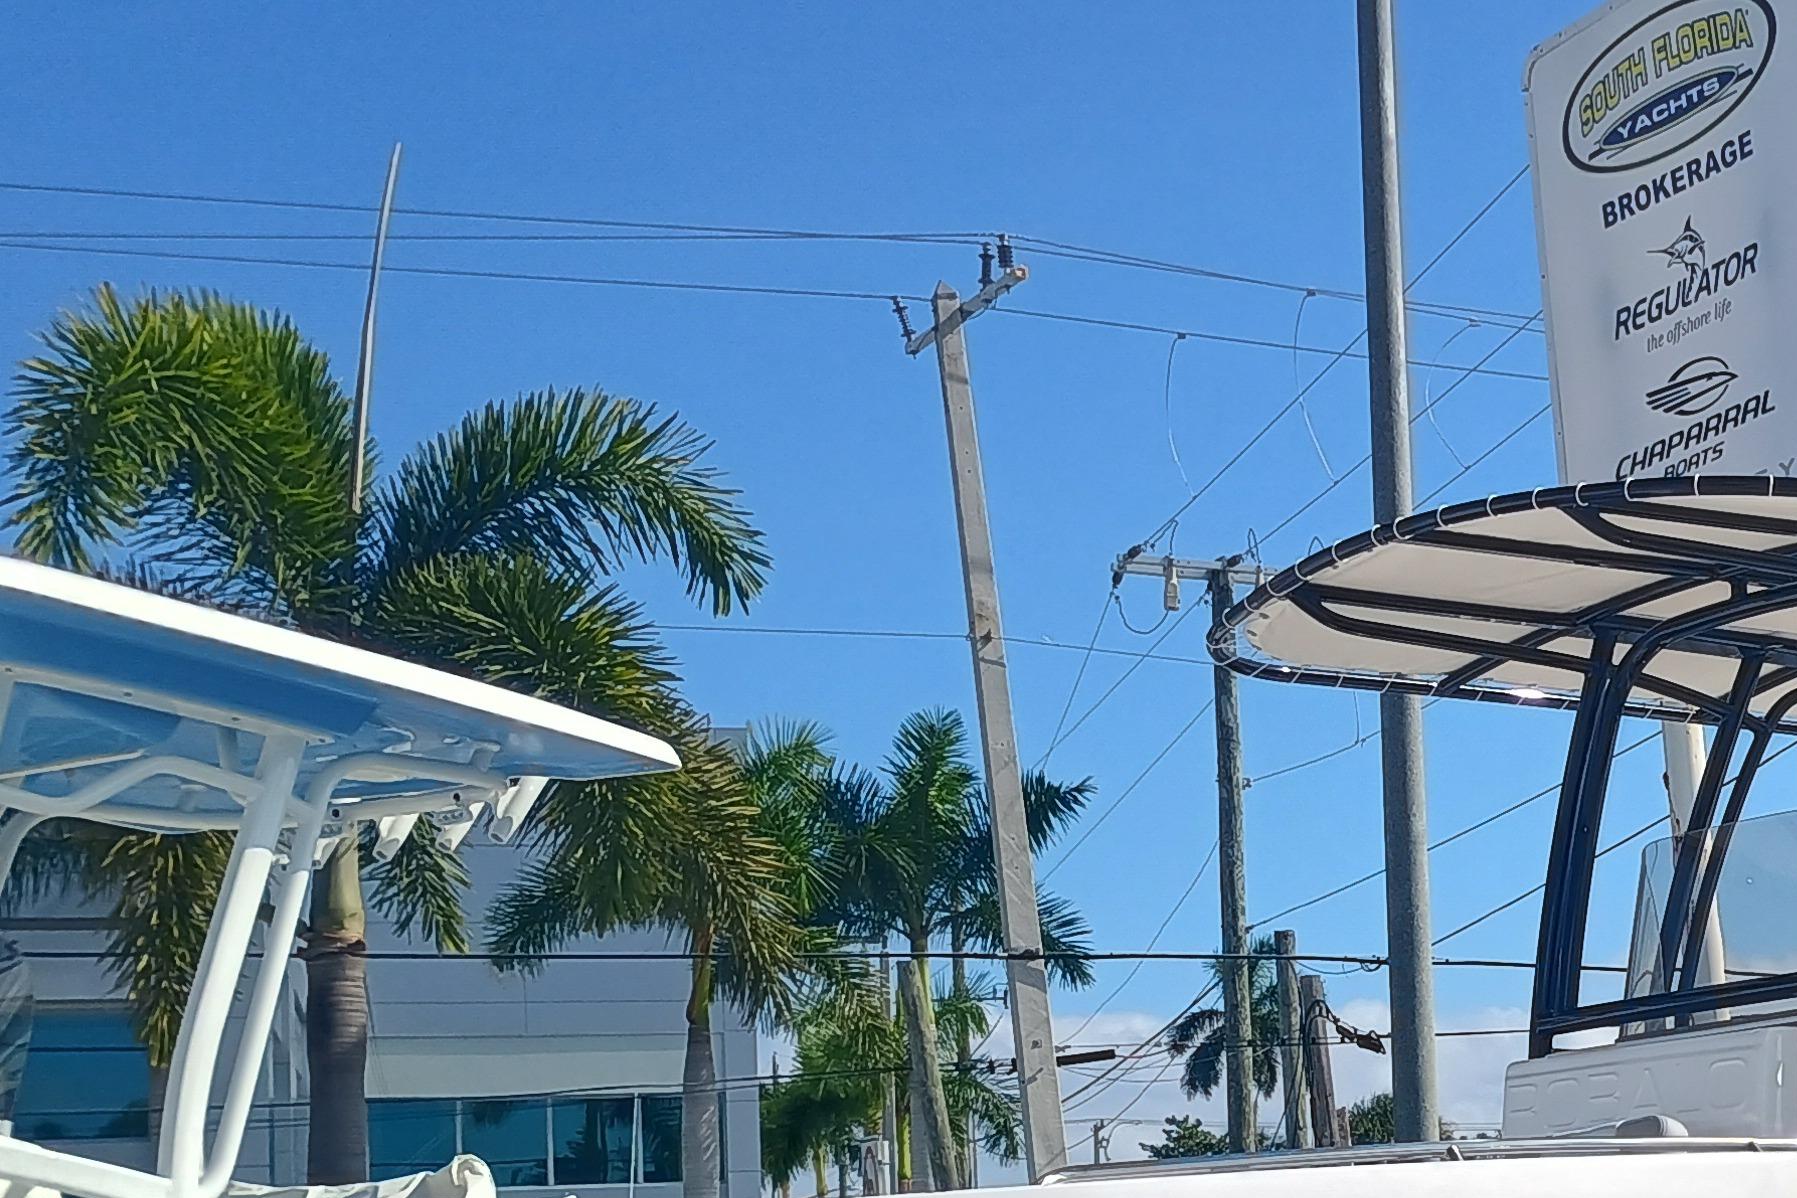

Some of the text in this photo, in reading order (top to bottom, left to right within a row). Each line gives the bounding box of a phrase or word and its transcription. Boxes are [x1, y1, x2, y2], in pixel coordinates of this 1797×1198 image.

[1579, 8, 1754, 138] SOUTH FLORIDA
[1617, 76, 1720, 139] YACHTS
[1602, 131, 1754, 229] BROKERAGE
[1615, 242, 1758, 341] REGULATOR
[1647, 298, 1732, 353] the offshore life
[1615, 389, 1776, 482] CHAPARRAL
[1664, 441, 1725, 477] BOATS
